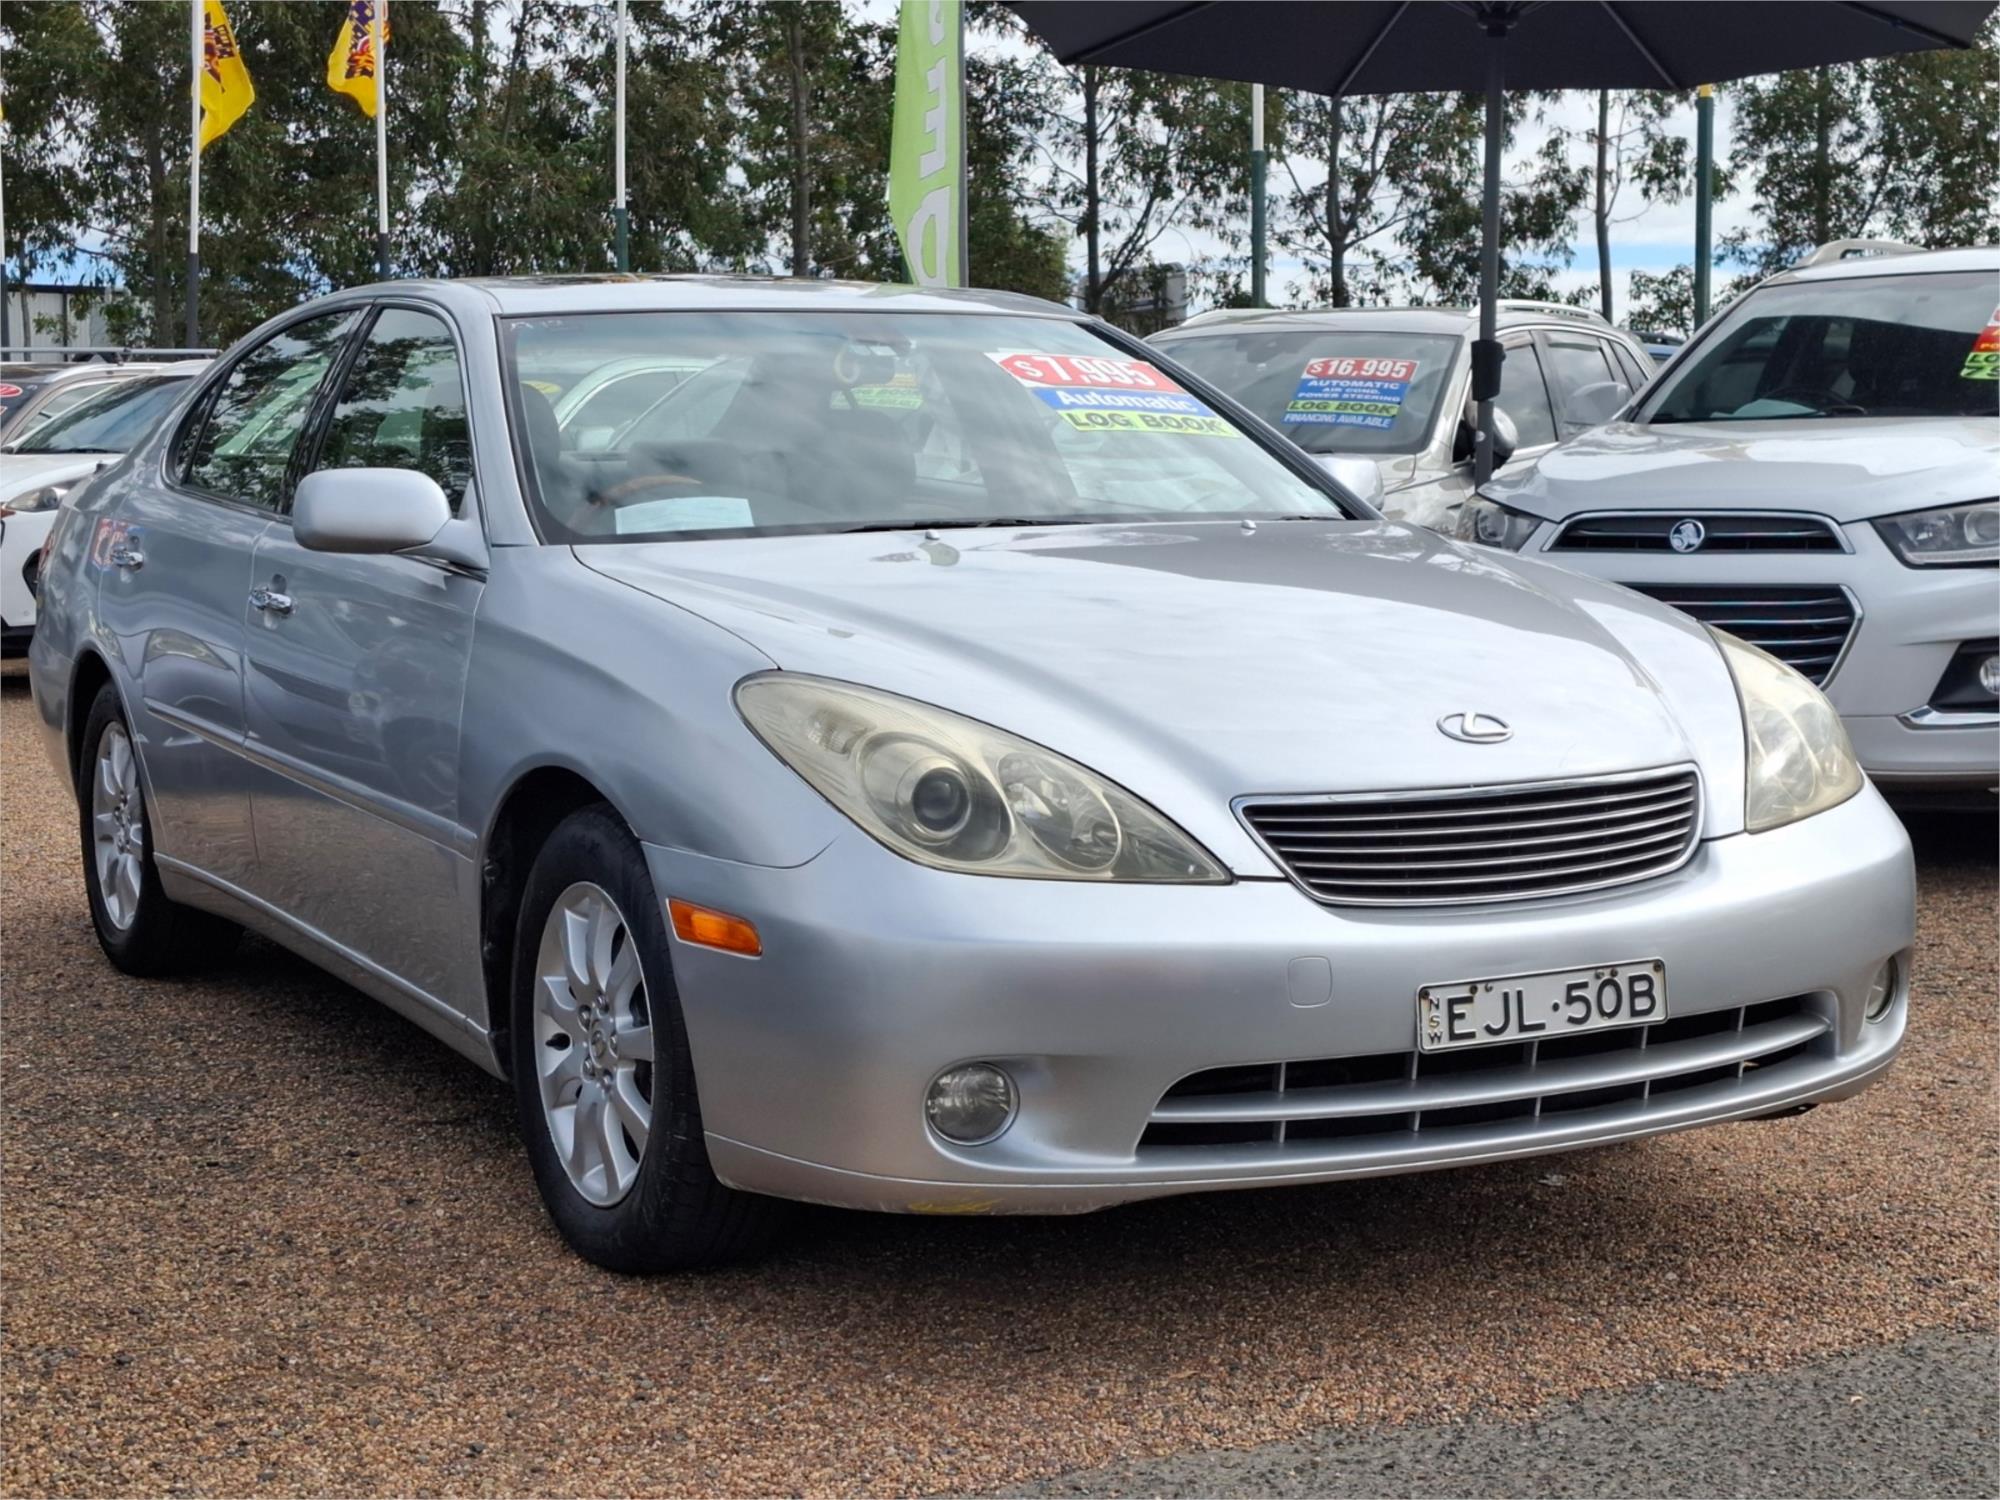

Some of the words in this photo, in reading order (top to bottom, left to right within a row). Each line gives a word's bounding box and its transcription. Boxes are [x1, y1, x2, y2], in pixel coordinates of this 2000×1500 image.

[1014, 356, 1157, 387] $7,995
[1310, 360, 1410, 379] $16,995
[1307, 380, 1400, 390] AUTOMATIC
[1055, 391, 1199, 412] Automatic
[1290, 401, 1330, 410] LOG
[1335, 402, 1396, 414] BOOK
[1065, 413, 1135, 428] LOG
[1143, 414, 1231, 434] BOOK
[1337, 415, 1393, 428] AVAILABLE
